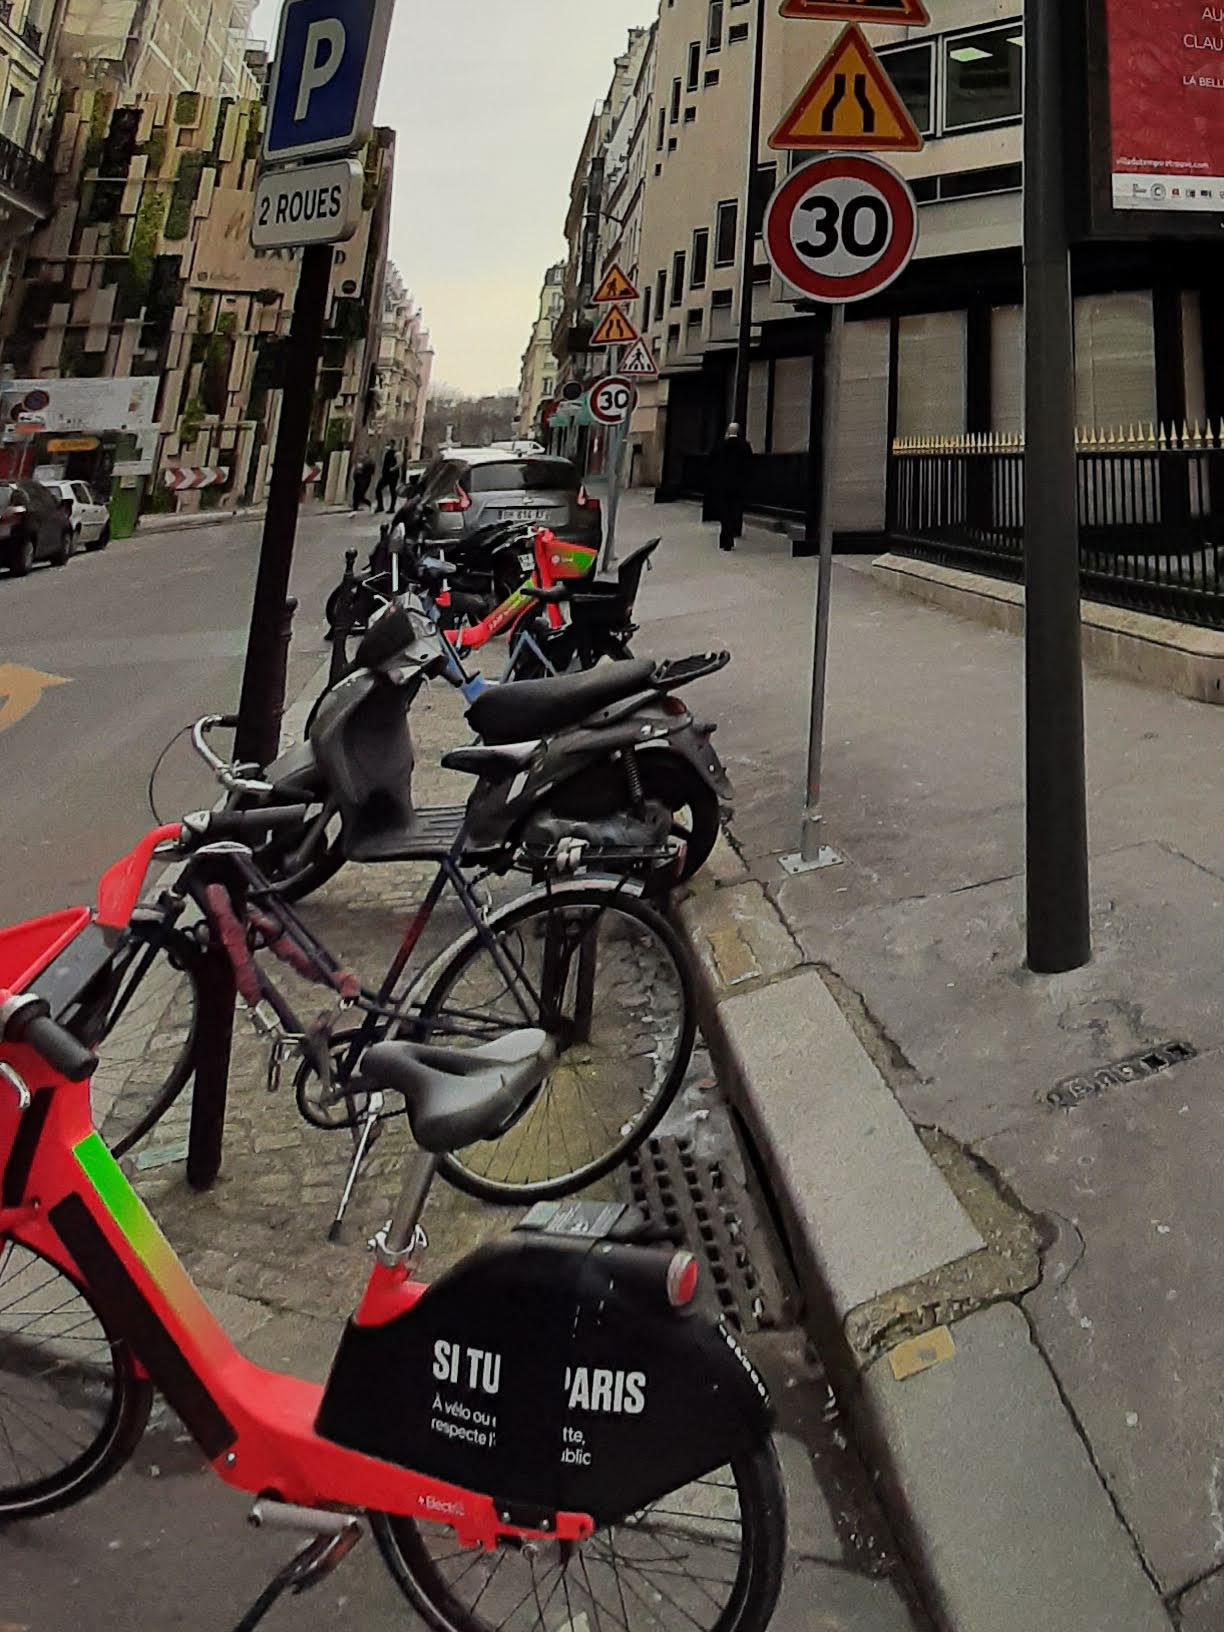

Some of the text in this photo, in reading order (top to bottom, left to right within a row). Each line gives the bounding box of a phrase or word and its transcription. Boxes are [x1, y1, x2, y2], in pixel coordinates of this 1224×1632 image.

[294, 18, 346, 121] P
[1183, 76, 1197, 86] LA
[258, 196, 271, 226] 2
[276, 185, 342, 224] ROUES
[795, 195, 888, 258] 30
[600, 389, 629, 411] 30
[433, 1340, 501, 1394] SI TU
[445, 1401, 471, 1419] vélo
[472, 1410, 490, 1424] ou
[431, 1418, 487, 1446] respecte
